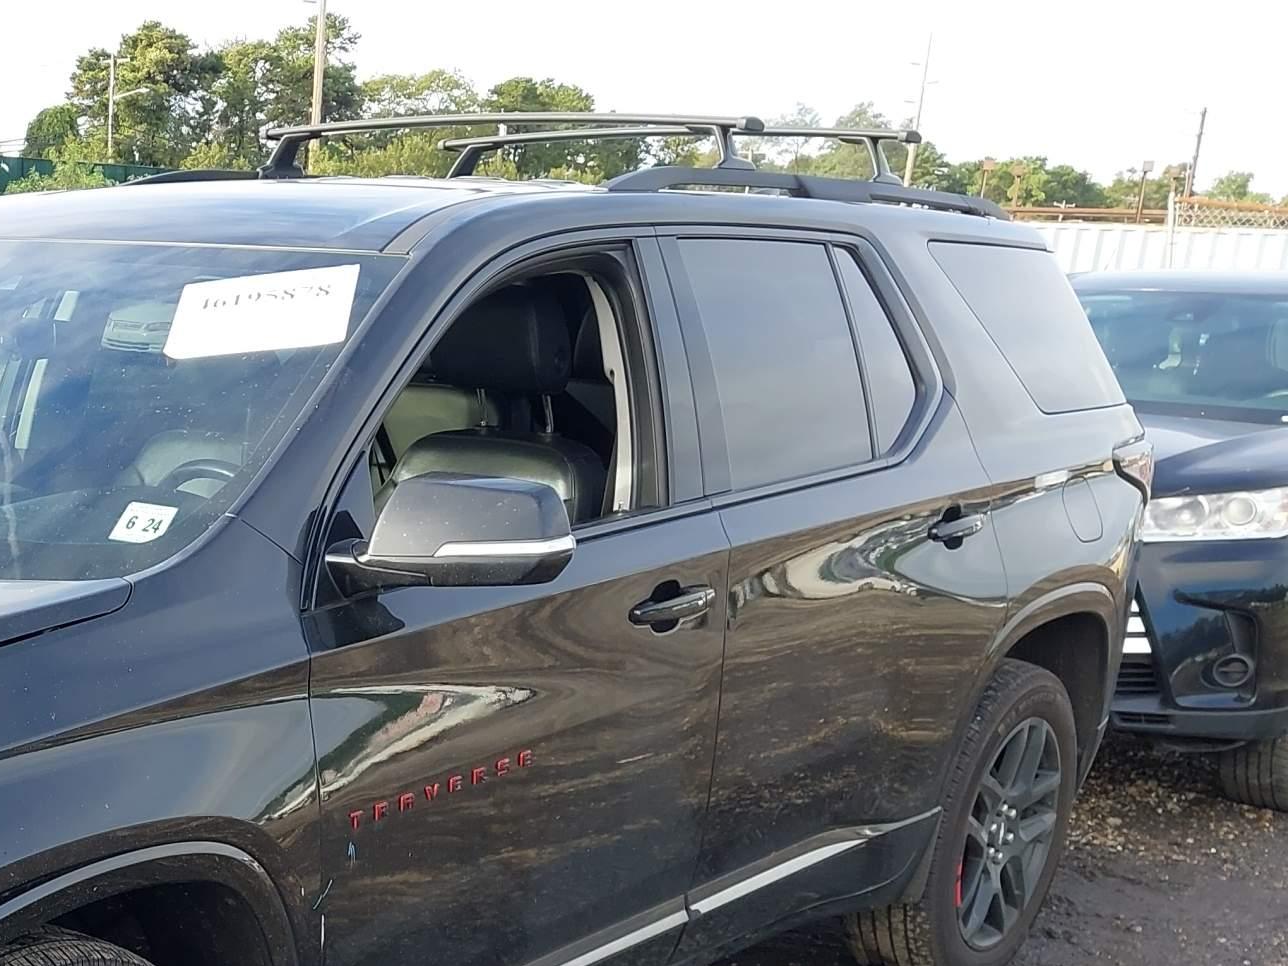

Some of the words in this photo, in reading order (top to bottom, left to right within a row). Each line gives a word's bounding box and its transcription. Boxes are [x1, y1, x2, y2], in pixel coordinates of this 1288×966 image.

[126, 515, 139, 530] 6
[142, 518, 163, 533] 24
[348, 749, 534, 831] TRAVERSE
